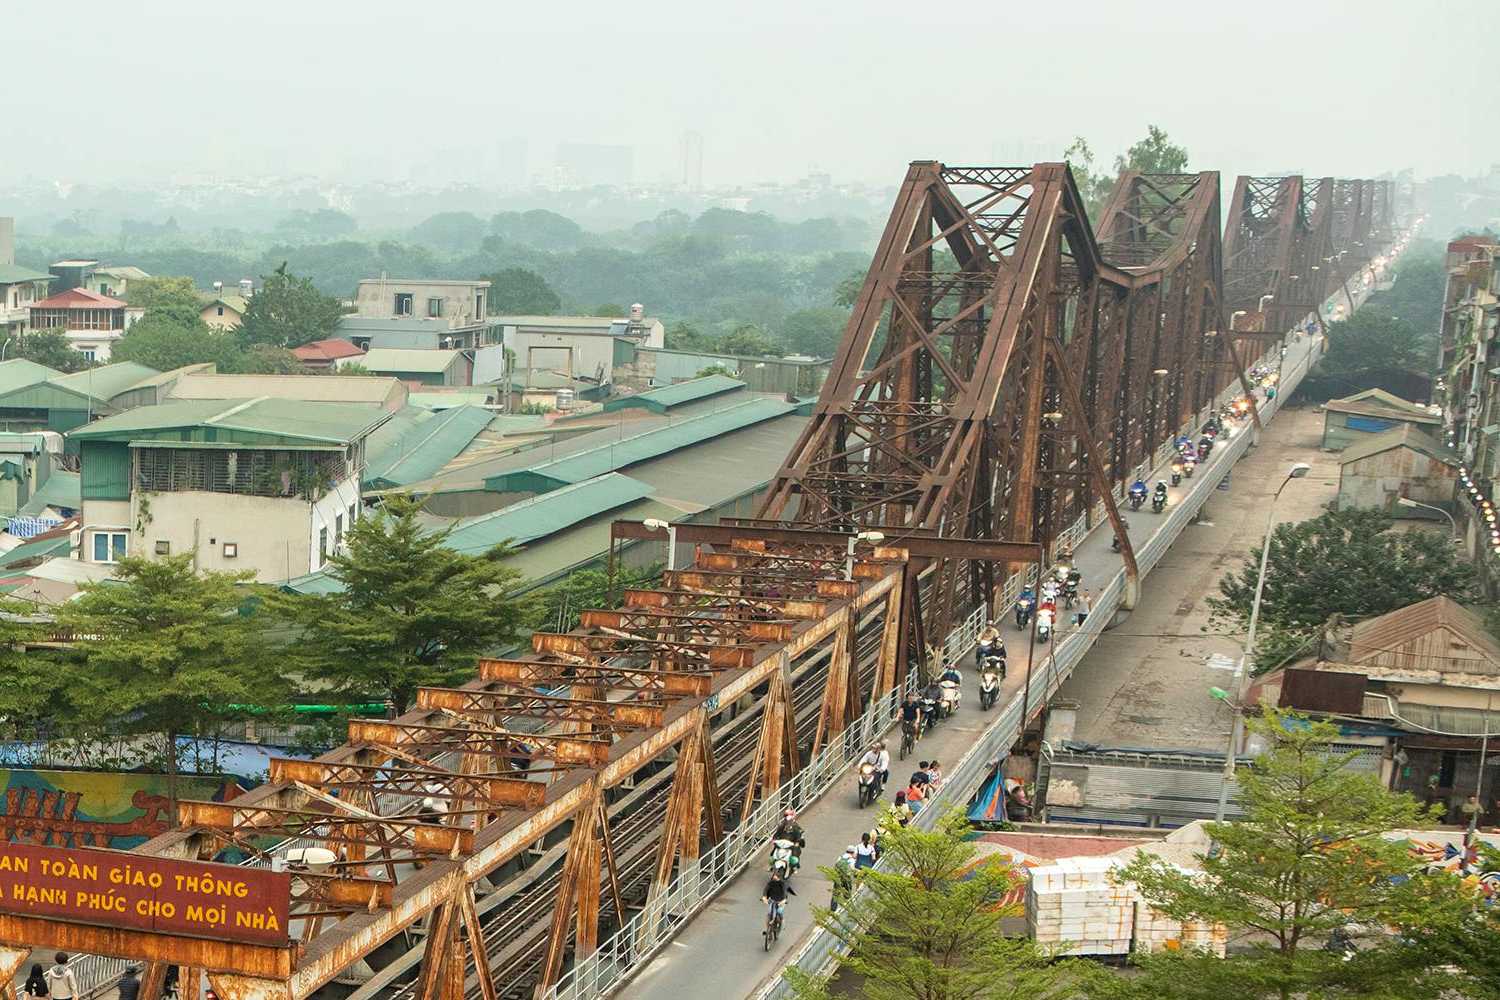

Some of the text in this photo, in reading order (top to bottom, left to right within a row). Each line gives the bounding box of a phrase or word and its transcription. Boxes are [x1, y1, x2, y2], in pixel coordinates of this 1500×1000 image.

[0, 855, 29, 873] AN
[40, 857, 98, 881] TOÀN
[174, 871, 249, 898] THÔNG
[13, 884, 67, 907] HẠNH
[76, 888, 127, 913] PHÚC
[136, 899, 176, 918] CHO
[235, 906, 279, 932] NHÀ
